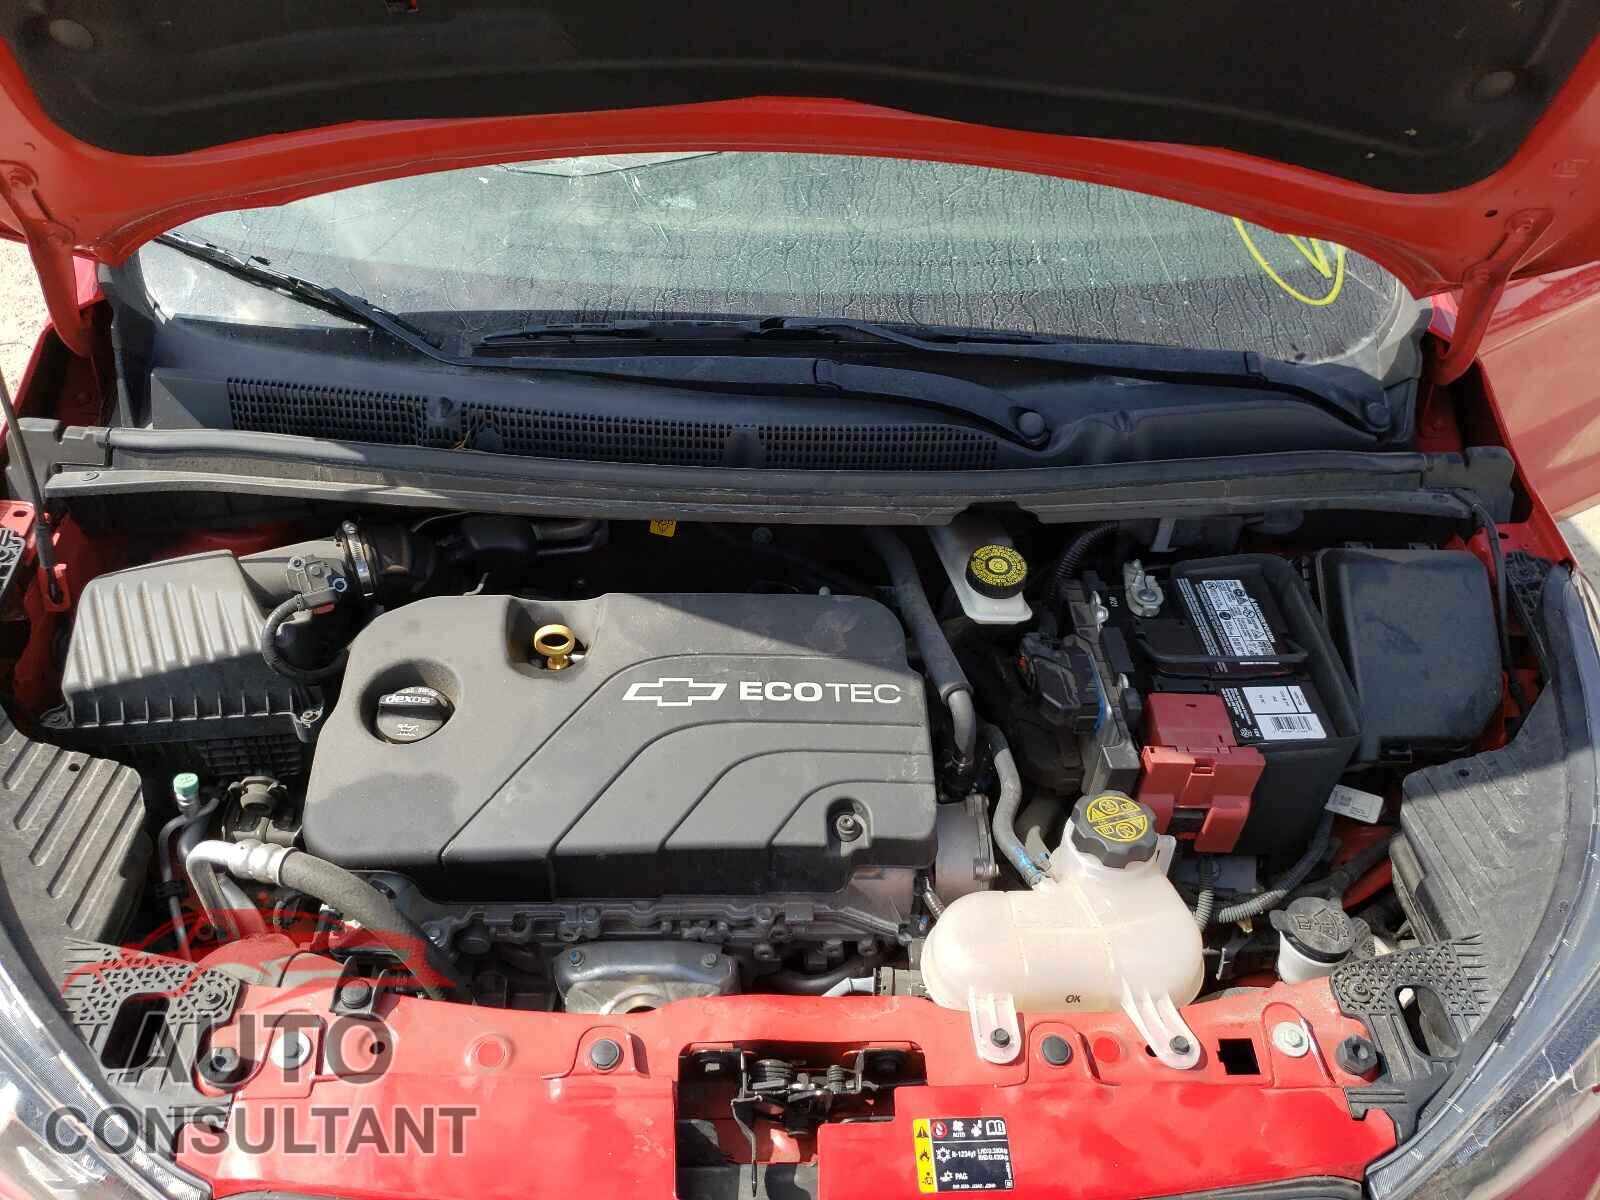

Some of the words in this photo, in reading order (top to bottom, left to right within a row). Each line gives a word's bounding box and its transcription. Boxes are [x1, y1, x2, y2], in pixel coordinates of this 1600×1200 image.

[739, 681, 902, 704] ECOTEC
[385, 693, 431, 704] dexos
[1065, 994, 1081, 1004] OK
